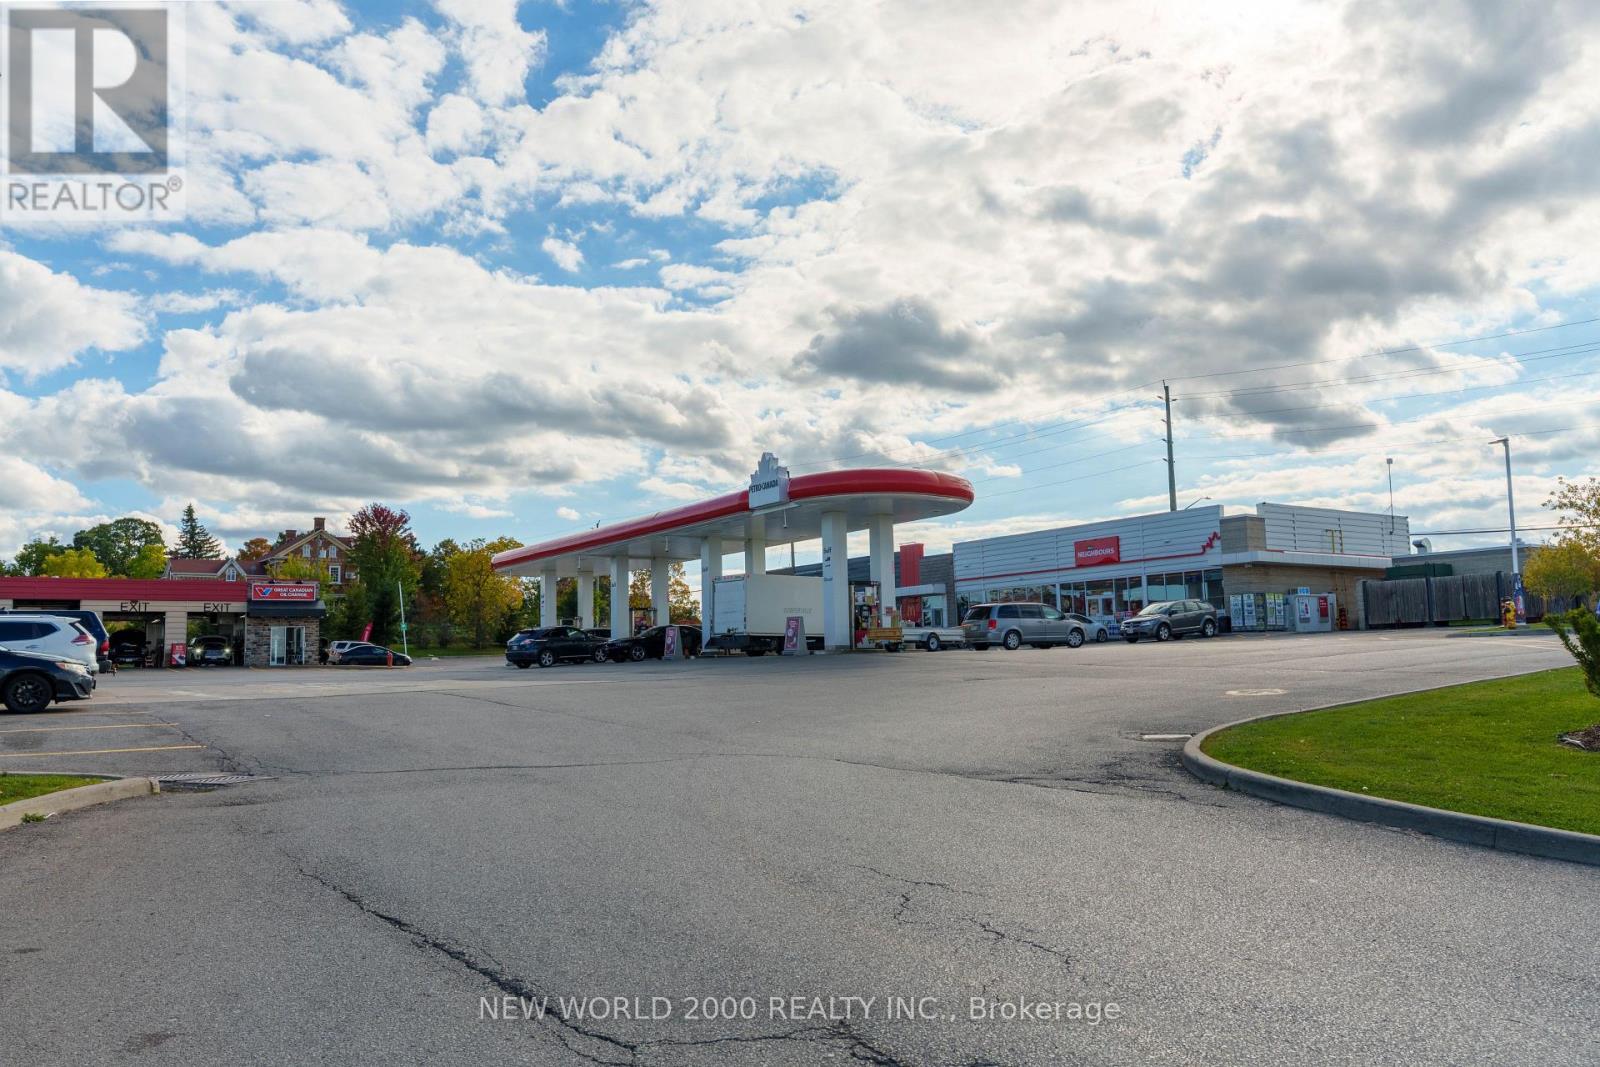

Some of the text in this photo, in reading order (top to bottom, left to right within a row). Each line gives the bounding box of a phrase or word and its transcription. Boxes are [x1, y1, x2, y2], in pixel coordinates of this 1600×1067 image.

[1077, 546, 1116, 558] NEIGHBOURS
[120, 601, 150, 613] EXIT
[203, 602, 232, 613] EXIT
